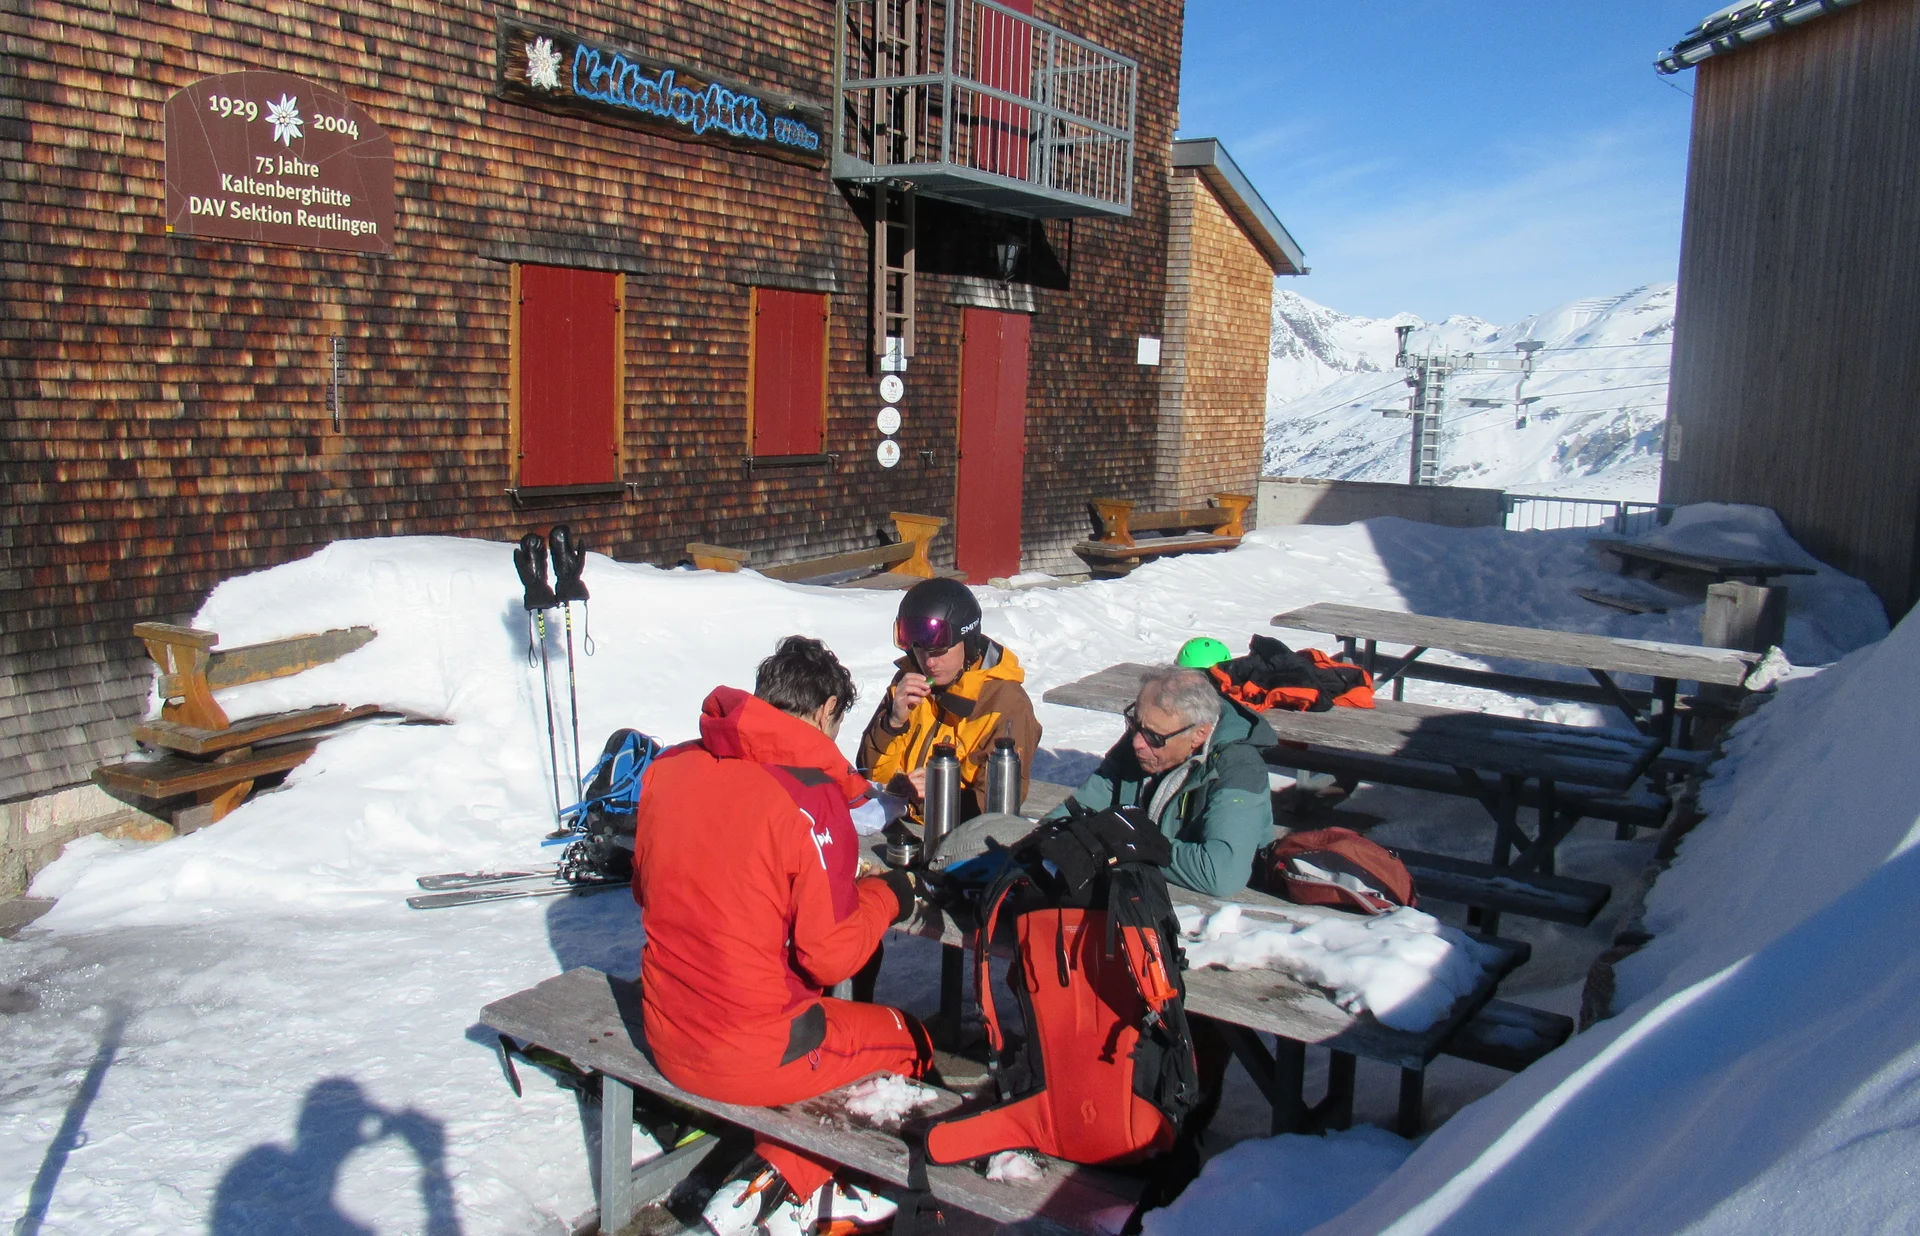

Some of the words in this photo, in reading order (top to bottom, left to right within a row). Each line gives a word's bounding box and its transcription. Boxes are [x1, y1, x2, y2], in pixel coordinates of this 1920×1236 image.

[208, 94, 259, 122] 1929
[313, 113, 359, 140] 2004
[255, 156, 275, 175] 75
[278, 155, 320, 178] Jahre
[221, 173, 351, 207] Kaltenberghütte
[189, 196, 226, 217] DAV
[230, 201, 293, 225] Sektion
[297, 209, 377, 236] Reutlingen
